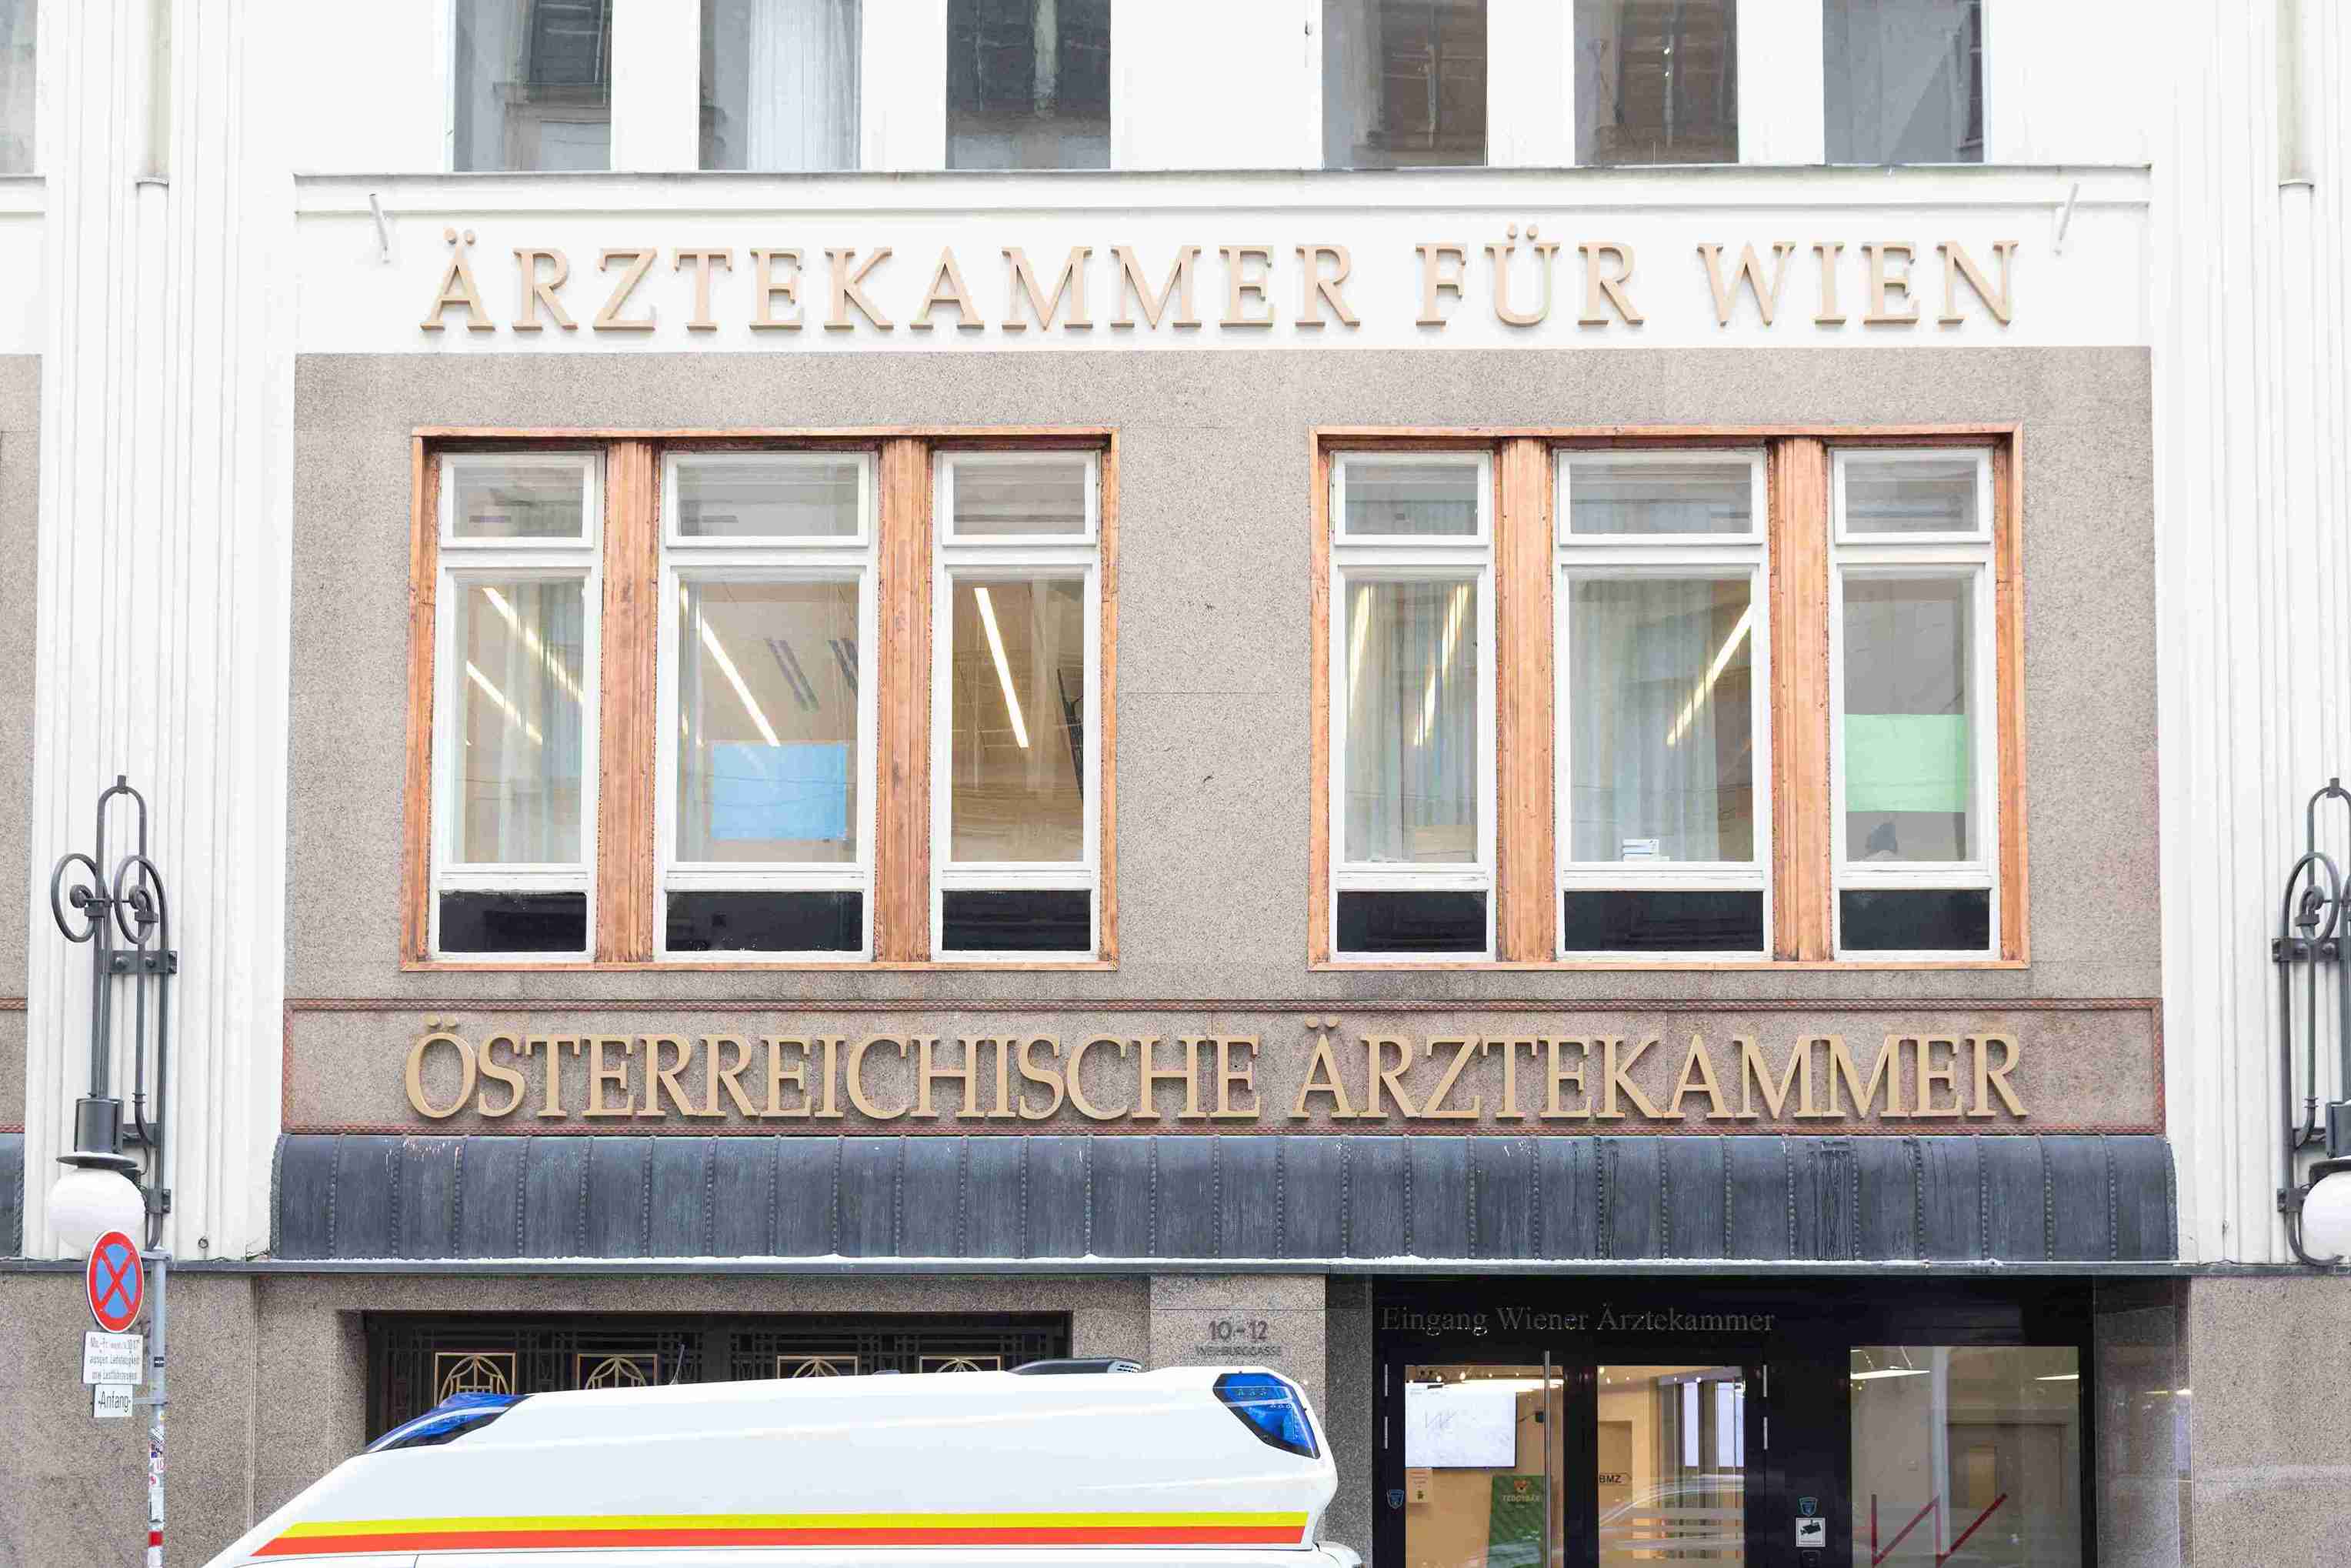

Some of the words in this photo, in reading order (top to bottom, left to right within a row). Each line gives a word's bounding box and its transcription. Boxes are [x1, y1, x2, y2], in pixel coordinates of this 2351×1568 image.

[419, 228, 1362, 332] ÄRZTEKAMMER
[1415, 223, 1645, 329] FÜR
[1696, 239, 2019, 327] WIEN
[405, 1014, 1260, 1120] ÖSTERREICHISCHE
[1286, 1014, 2029, 1120] ÄRZTEKAMMER
[1379, 1306, 1489, 1336] Eingang
[1495, 1306, 1589, 1331] Wiener
[1596, 1301, 1776, 1331] Ärztekammer
[1599, 1474, 1622, 1483] BMZ
